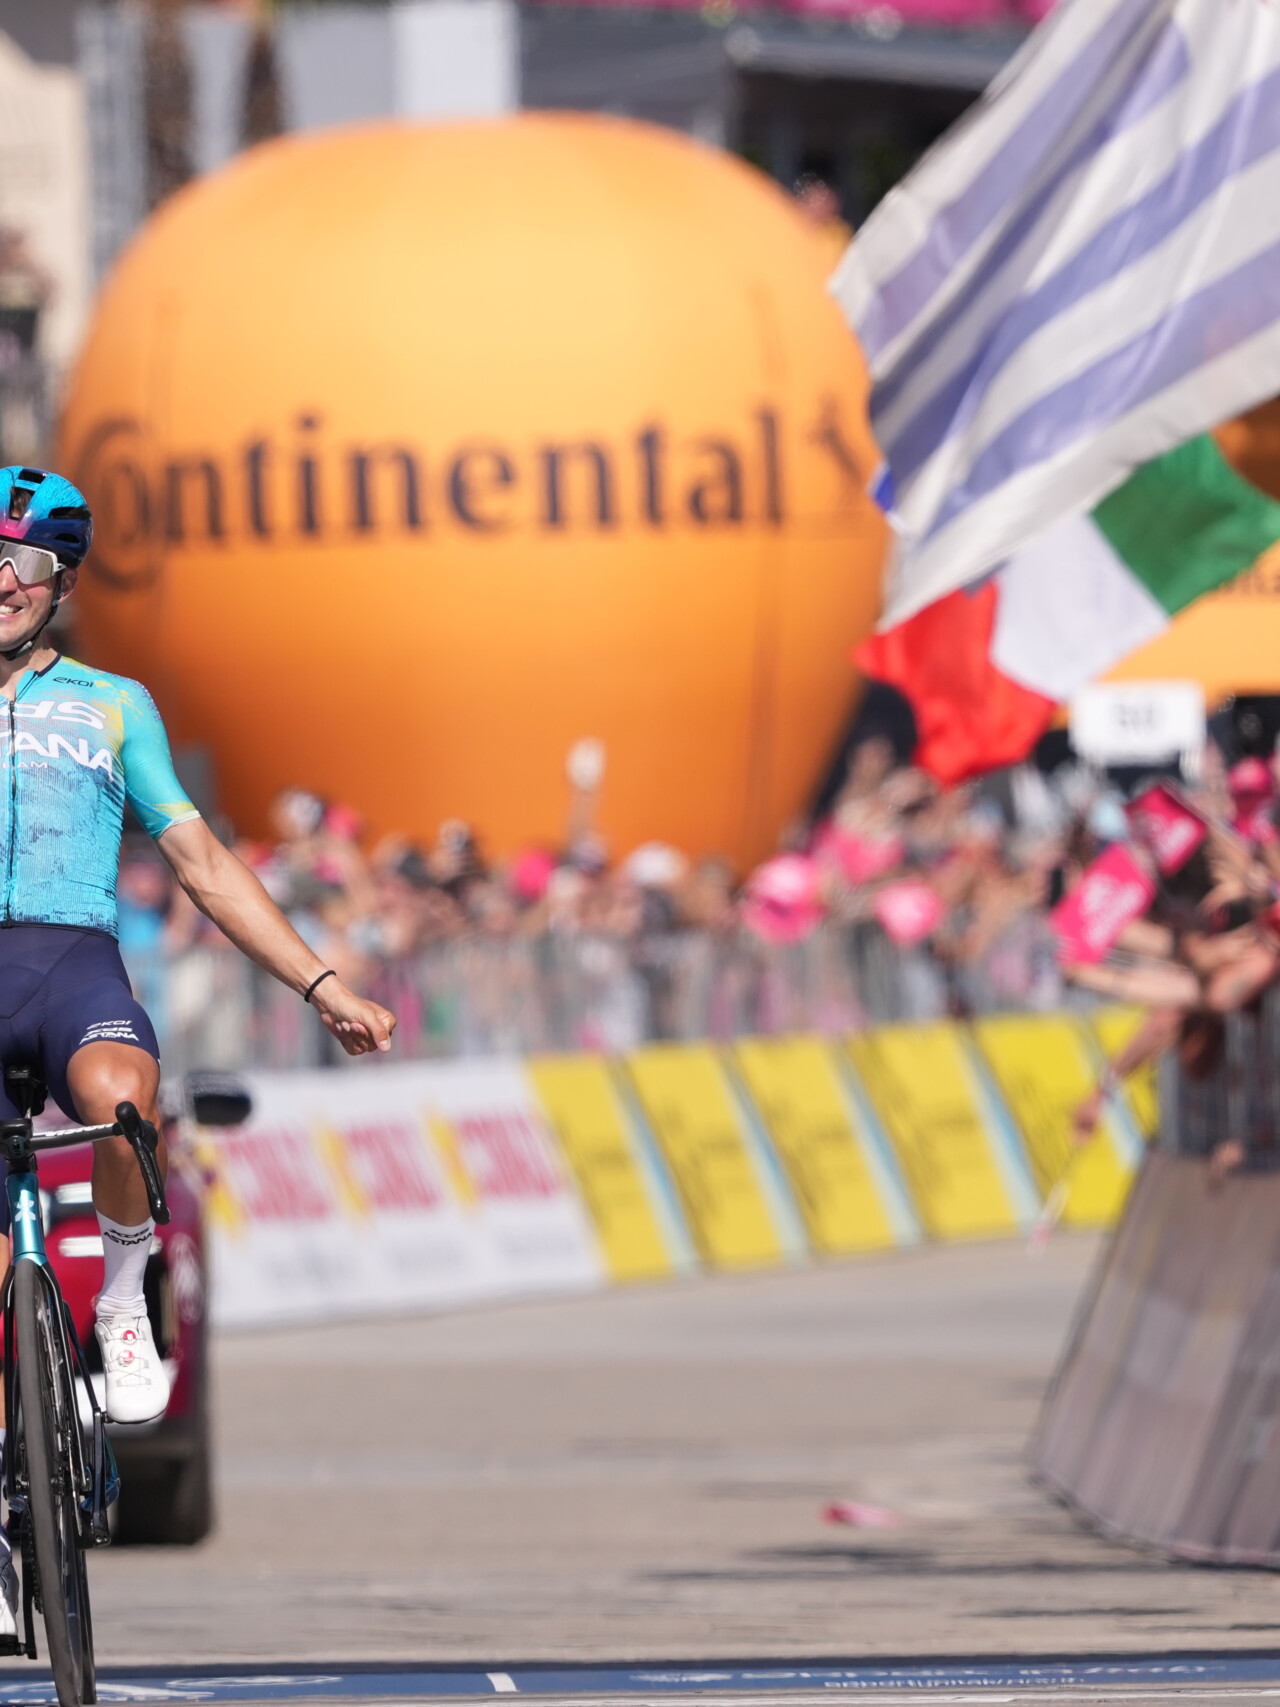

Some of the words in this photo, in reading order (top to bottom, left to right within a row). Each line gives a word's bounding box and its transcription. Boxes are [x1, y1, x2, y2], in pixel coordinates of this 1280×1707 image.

[78, 404, 786, 592] Continental
[79, 1032, 139, 1045] ASTANA
[103, 1231, 153, 1246] ASTANA
